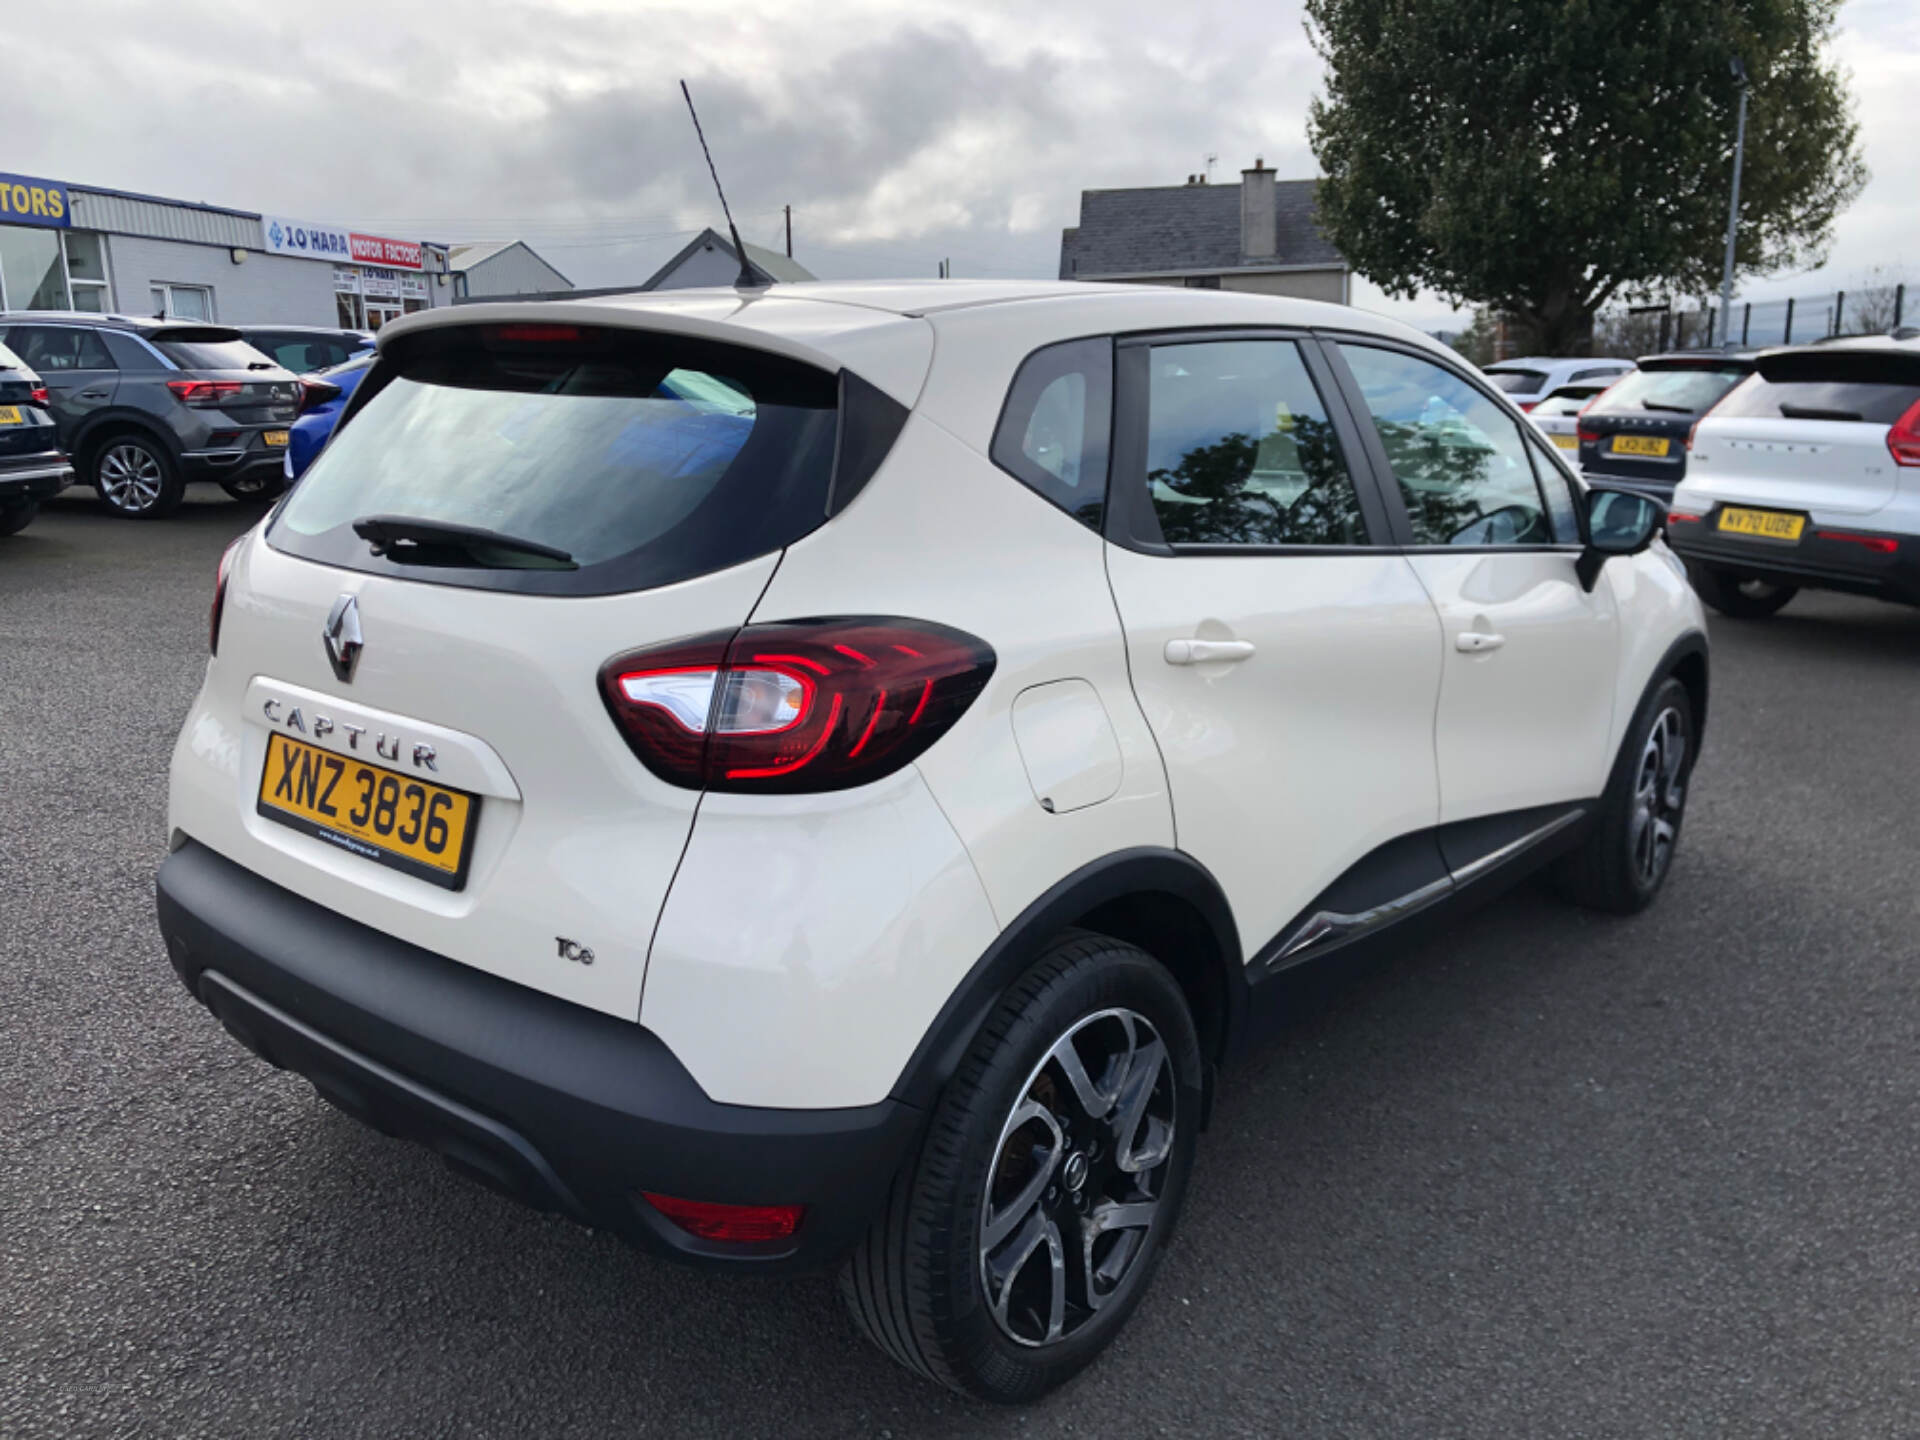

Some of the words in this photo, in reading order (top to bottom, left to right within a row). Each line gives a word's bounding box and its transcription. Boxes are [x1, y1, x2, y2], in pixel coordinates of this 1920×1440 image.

[352, 238, 384, 259] MOTOR
[385, 244, 420, 264] FACTORS
[263, 698, 438, 772] CAPTUR
[275, 742, 345, 818] XNZ
[350, 768, 454, 855] 3836
